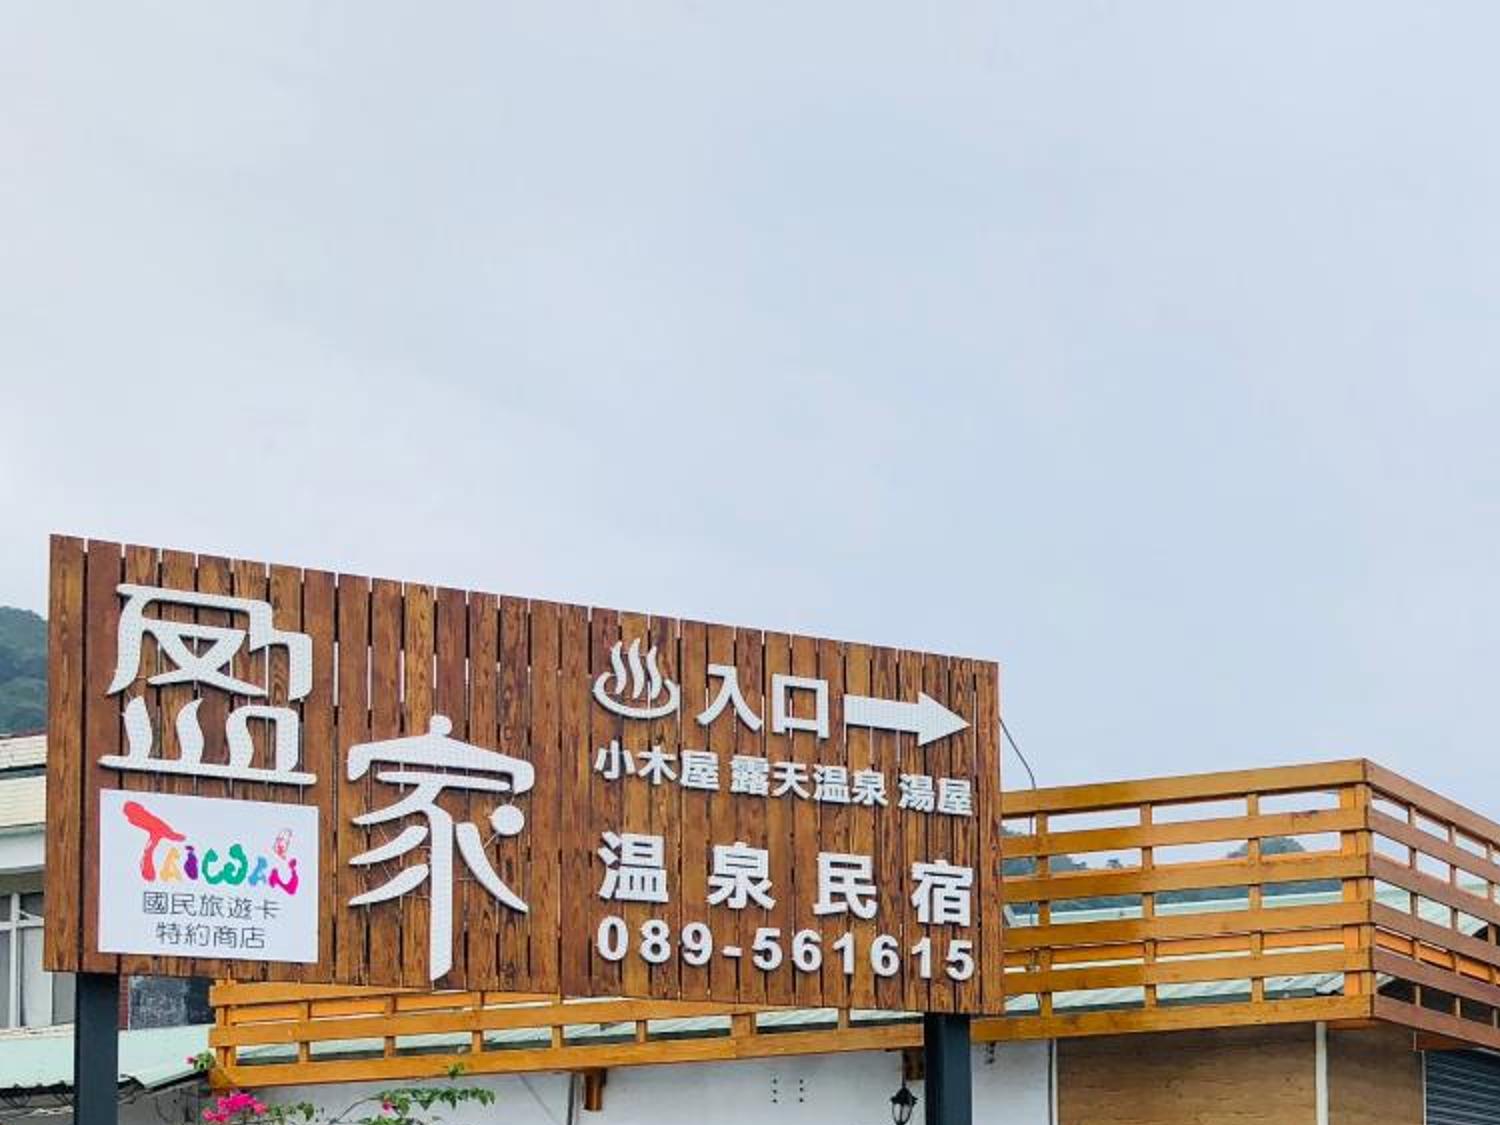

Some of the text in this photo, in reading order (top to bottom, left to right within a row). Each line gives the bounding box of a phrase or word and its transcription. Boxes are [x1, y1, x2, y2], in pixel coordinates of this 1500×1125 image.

[697, 663, 830, 740] 入口
[99, 583, 535, 982] 盈家
[595, 739, 974, 817] 小木屋 露天温泉 湯屋
[143, 891, 281, 920] 國民旅遊卡
[597, 831, 974, 928] 温泉民宿
[156, 921, 266, 949] 特約商店
[597, 915, 975, 982] 089-561615
